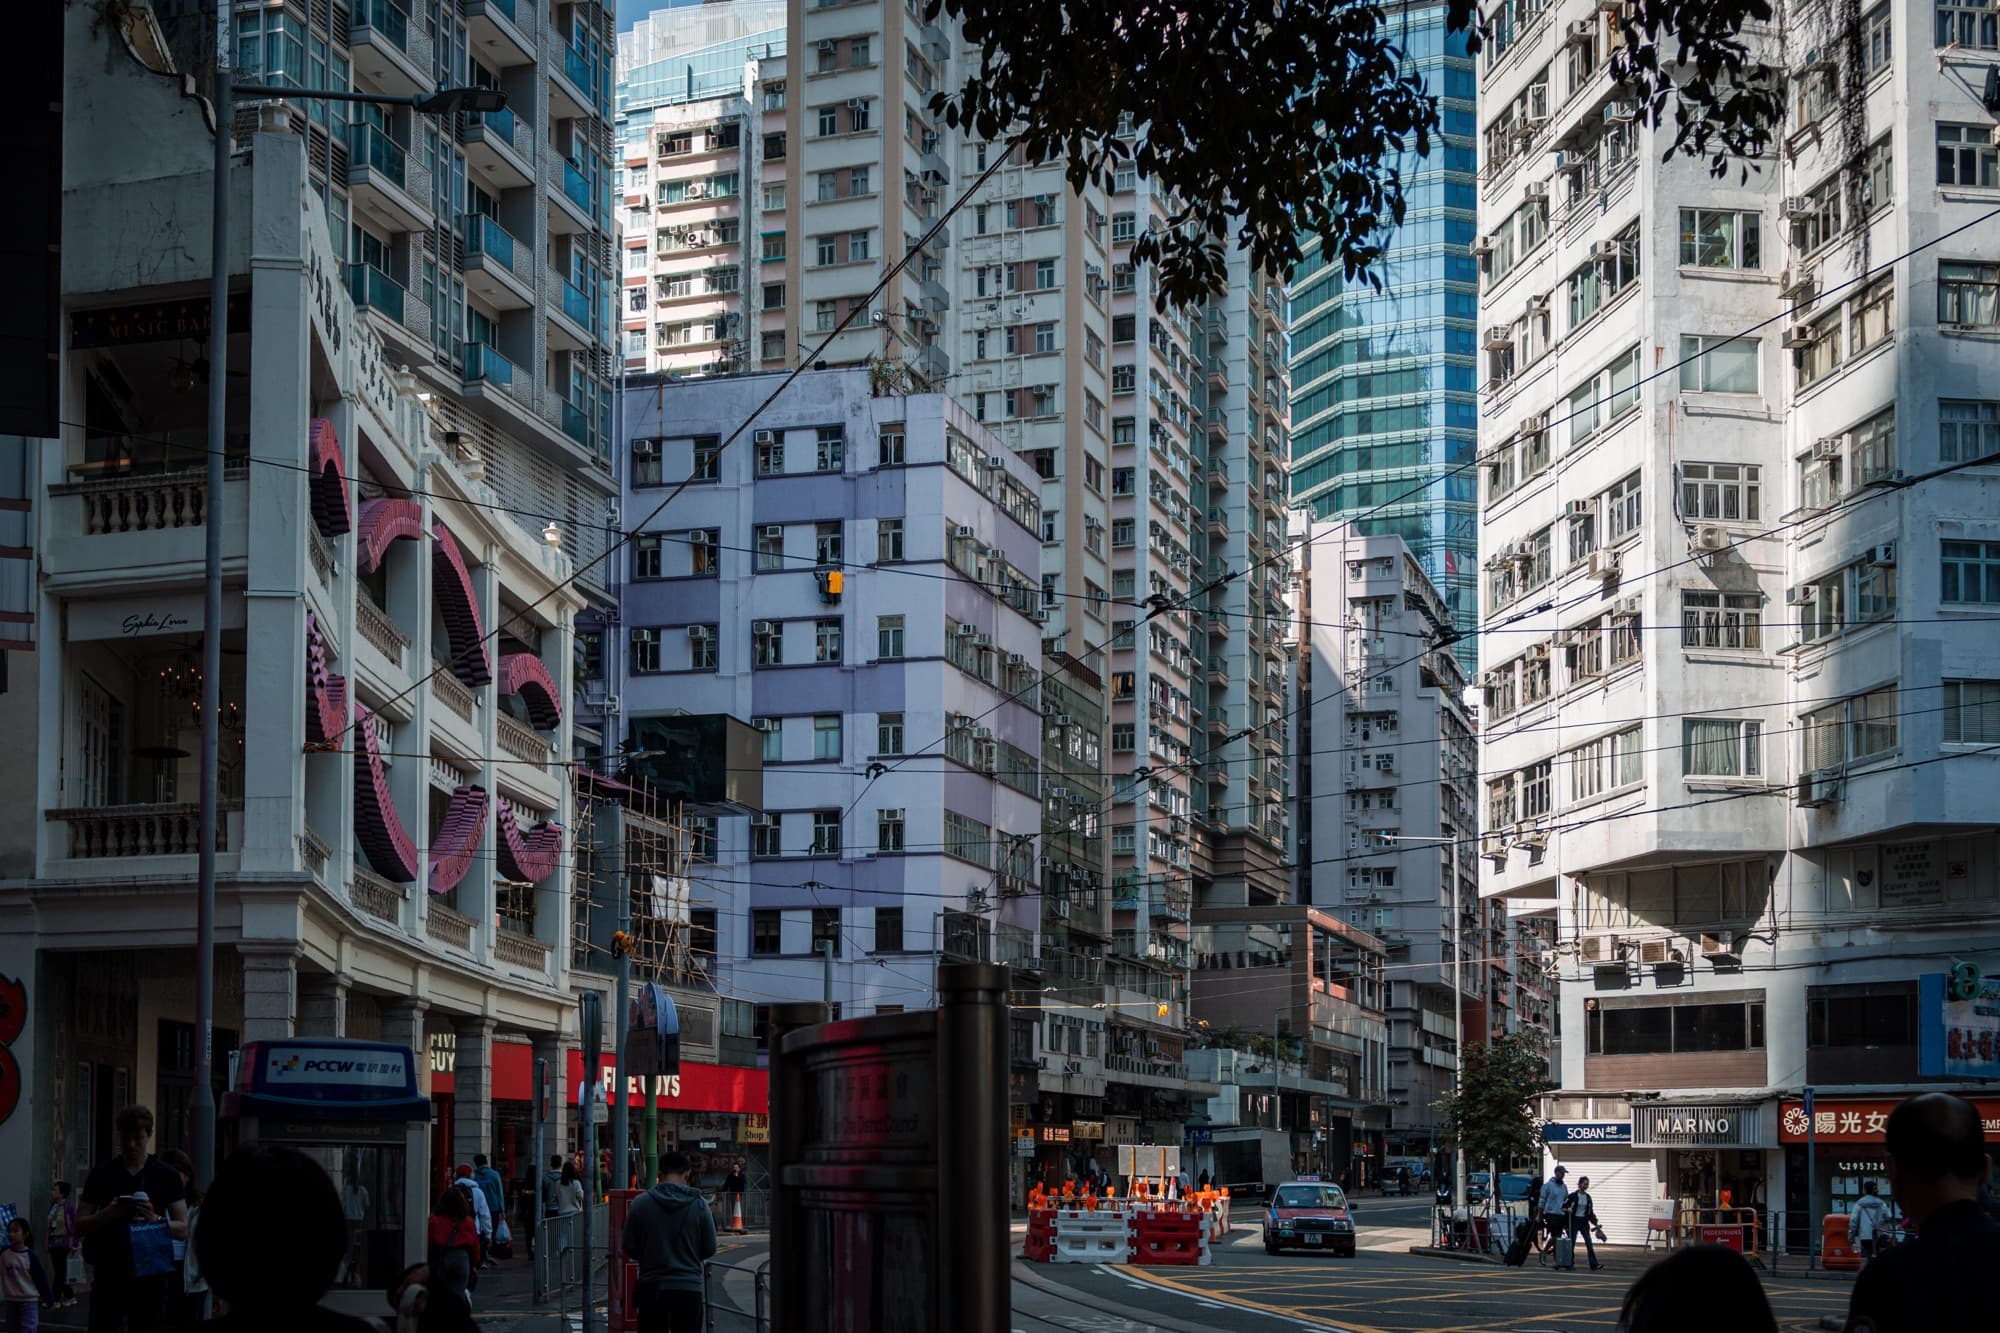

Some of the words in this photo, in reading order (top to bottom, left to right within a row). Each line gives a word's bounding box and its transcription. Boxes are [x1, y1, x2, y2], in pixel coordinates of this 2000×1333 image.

[303, 1060, 354, 1073] PCCW
[1657, 1118, 1729, 1134] MARINO
[1815, 1111, 1888, 1134] 陽光女
[1567, 1127, 1605, 1139] SOBAN
[1703, 1229, 1742, 1237] PEDESTRIANS
